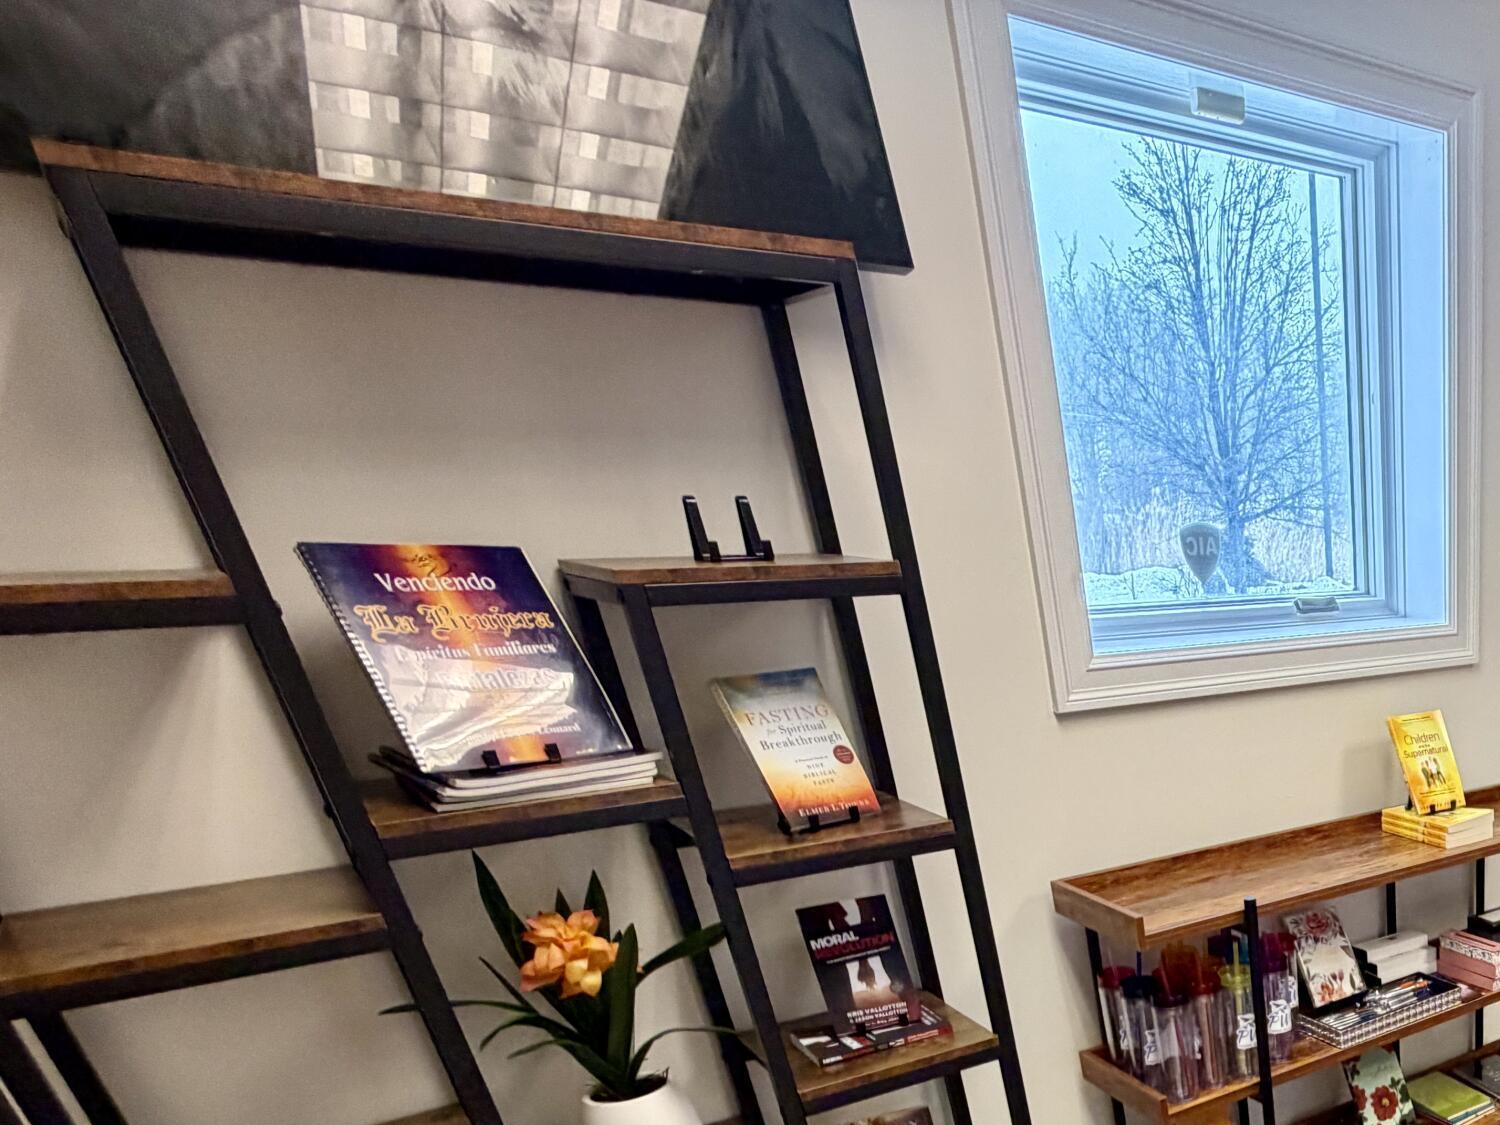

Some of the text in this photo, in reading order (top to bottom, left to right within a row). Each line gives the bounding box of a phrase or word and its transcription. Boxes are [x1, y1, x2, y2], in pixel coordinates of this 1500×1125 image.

[374, 571, 497, 594] Venciendo
[352, 604, 420, 643] La
[744, 703, 830, 727] FASTING
[779, 720, 828, 737] Spiritual
[1403, 732, 1441, 746] Children
[759, 731, 844, 752] Breakthrough
[1403, 744, 1449, 759] Supernatural
[809, 930, 859, 951] MORAL
